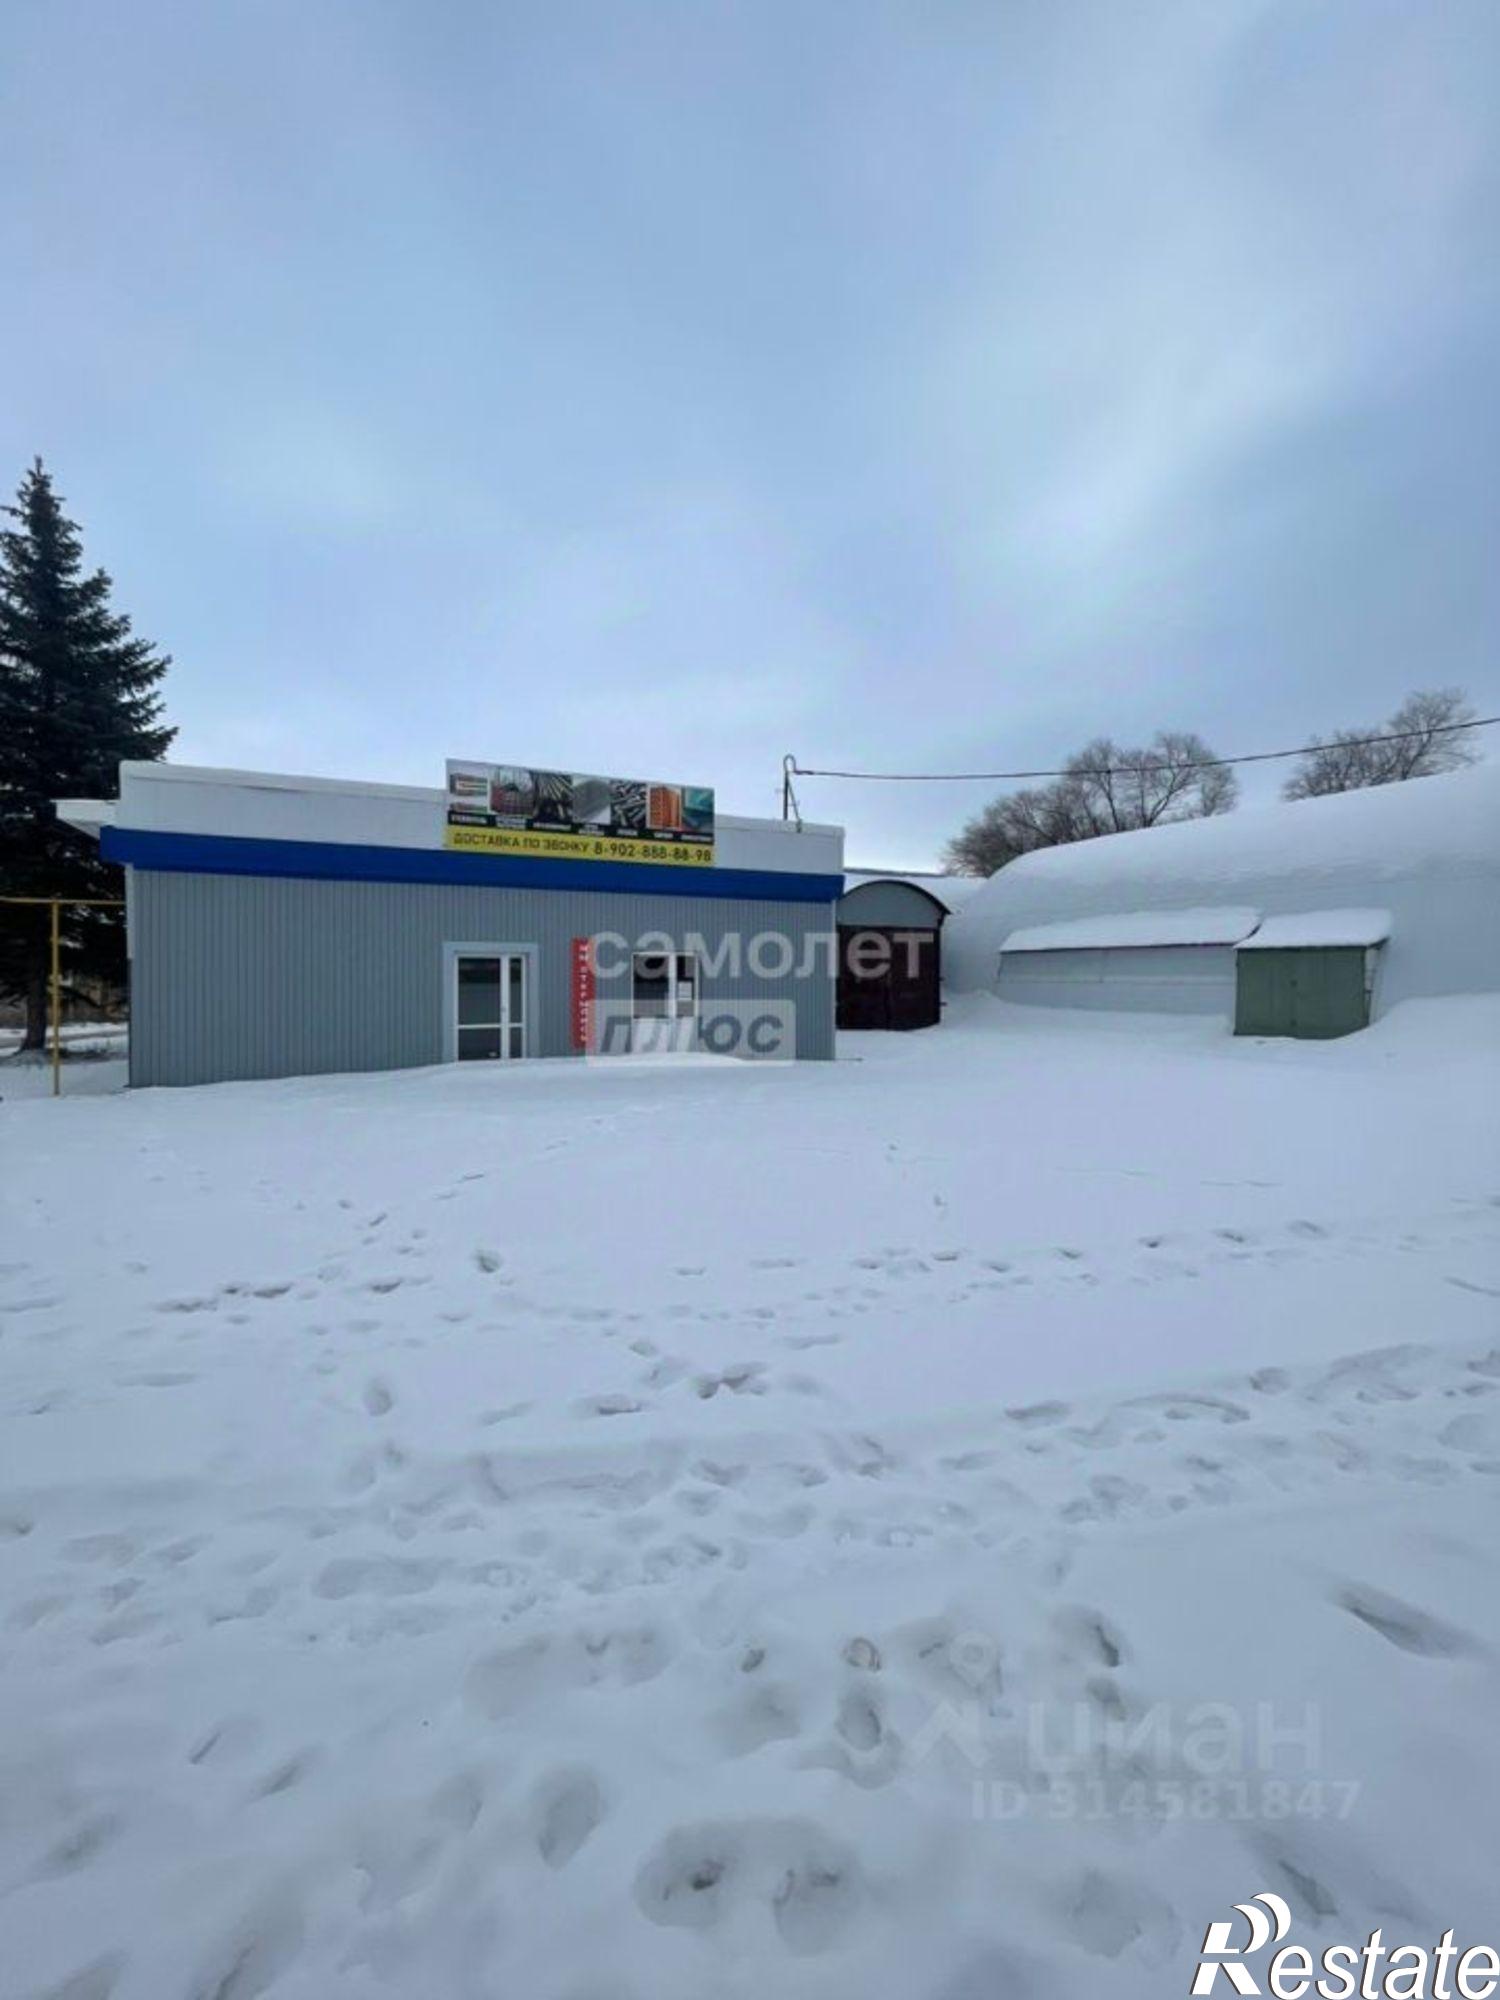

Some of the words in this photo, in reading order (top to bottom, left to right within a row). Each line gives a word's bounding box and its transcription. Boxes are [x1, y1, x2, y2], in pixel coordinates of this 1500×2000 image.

[453, 832, 520, 847] ДОСТАВКА
[524, 838, 541, 849] ПО
[543, 839, 590, 853] ЗВОНКУ
